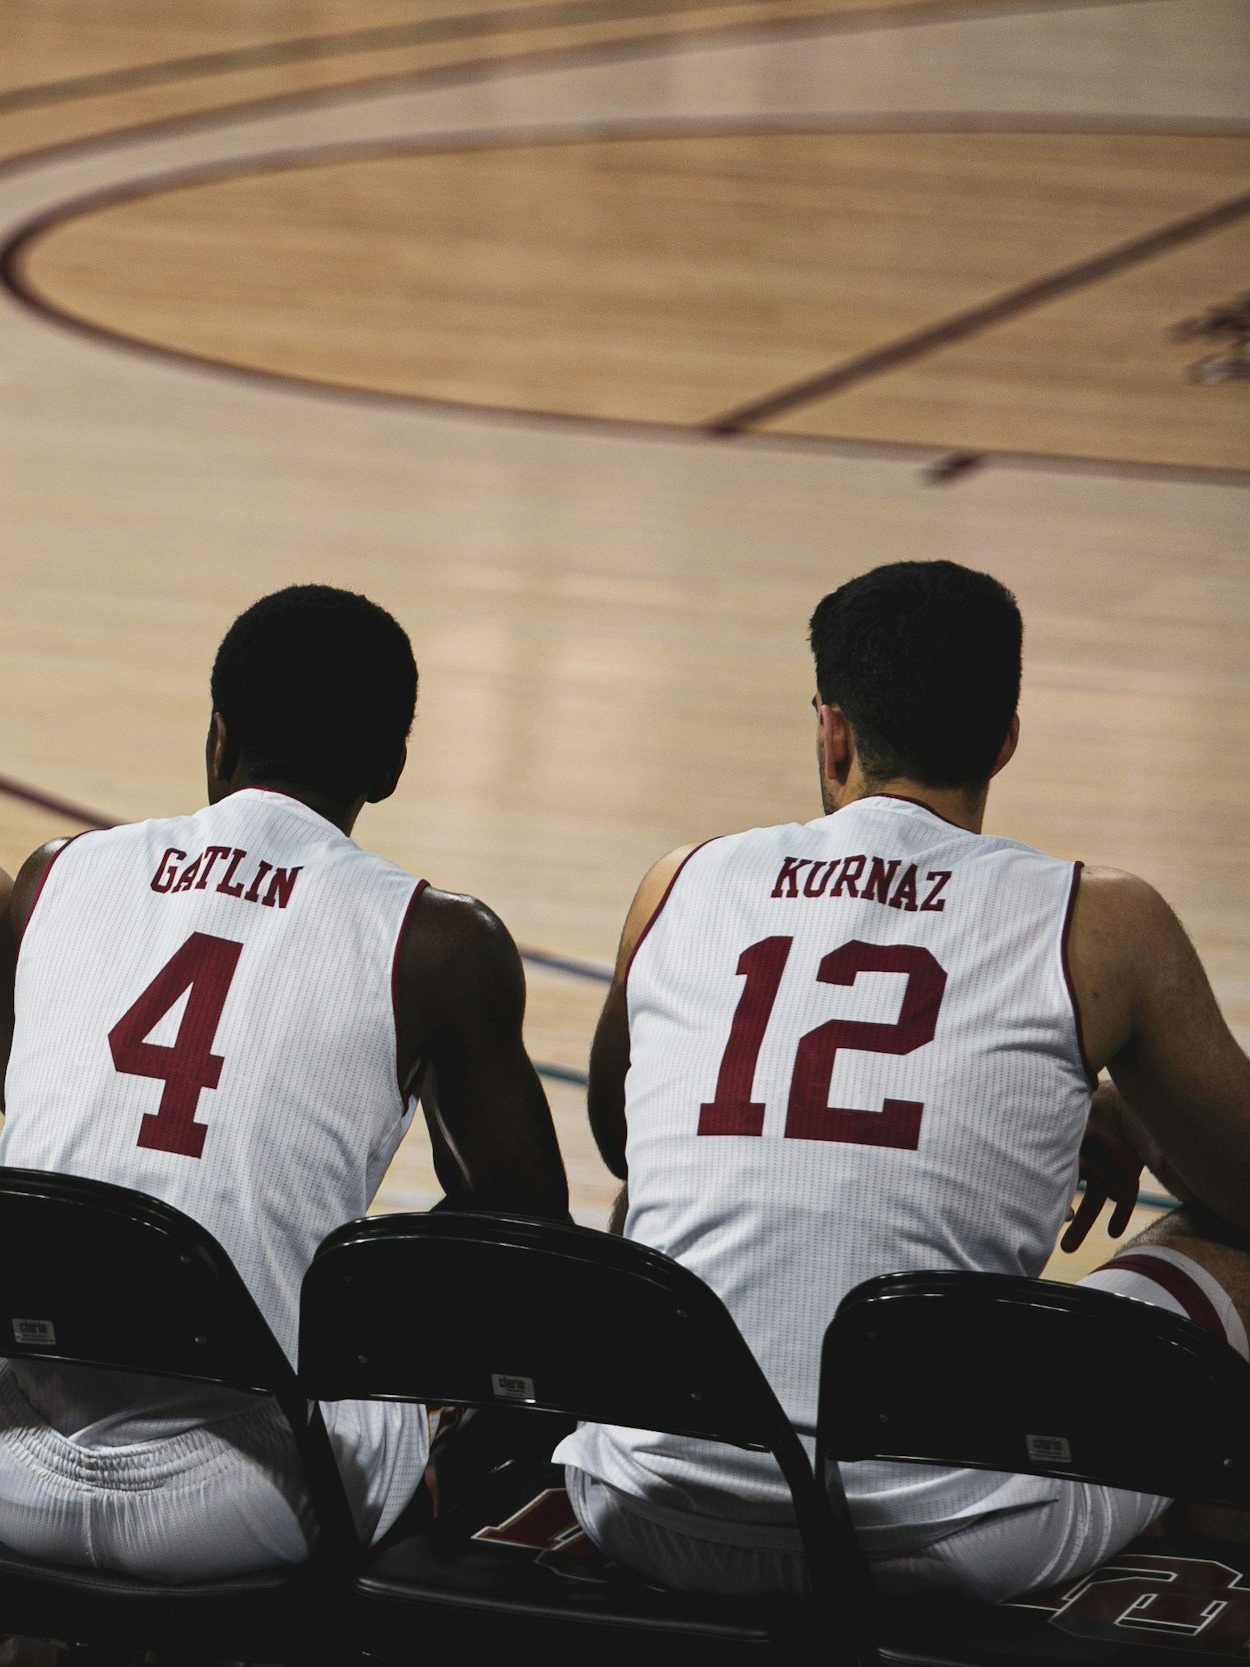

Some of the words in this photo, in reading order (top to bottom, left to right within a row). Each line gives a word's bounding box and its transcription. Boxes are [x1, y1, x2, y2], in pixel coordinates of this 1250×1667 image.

[150, 845, 303, 909] GATLIN
[770, 855, 952, 912] KURNAZ
[108, 931, 243, 1159] 4
[697, 936, 947, 1150] 12
